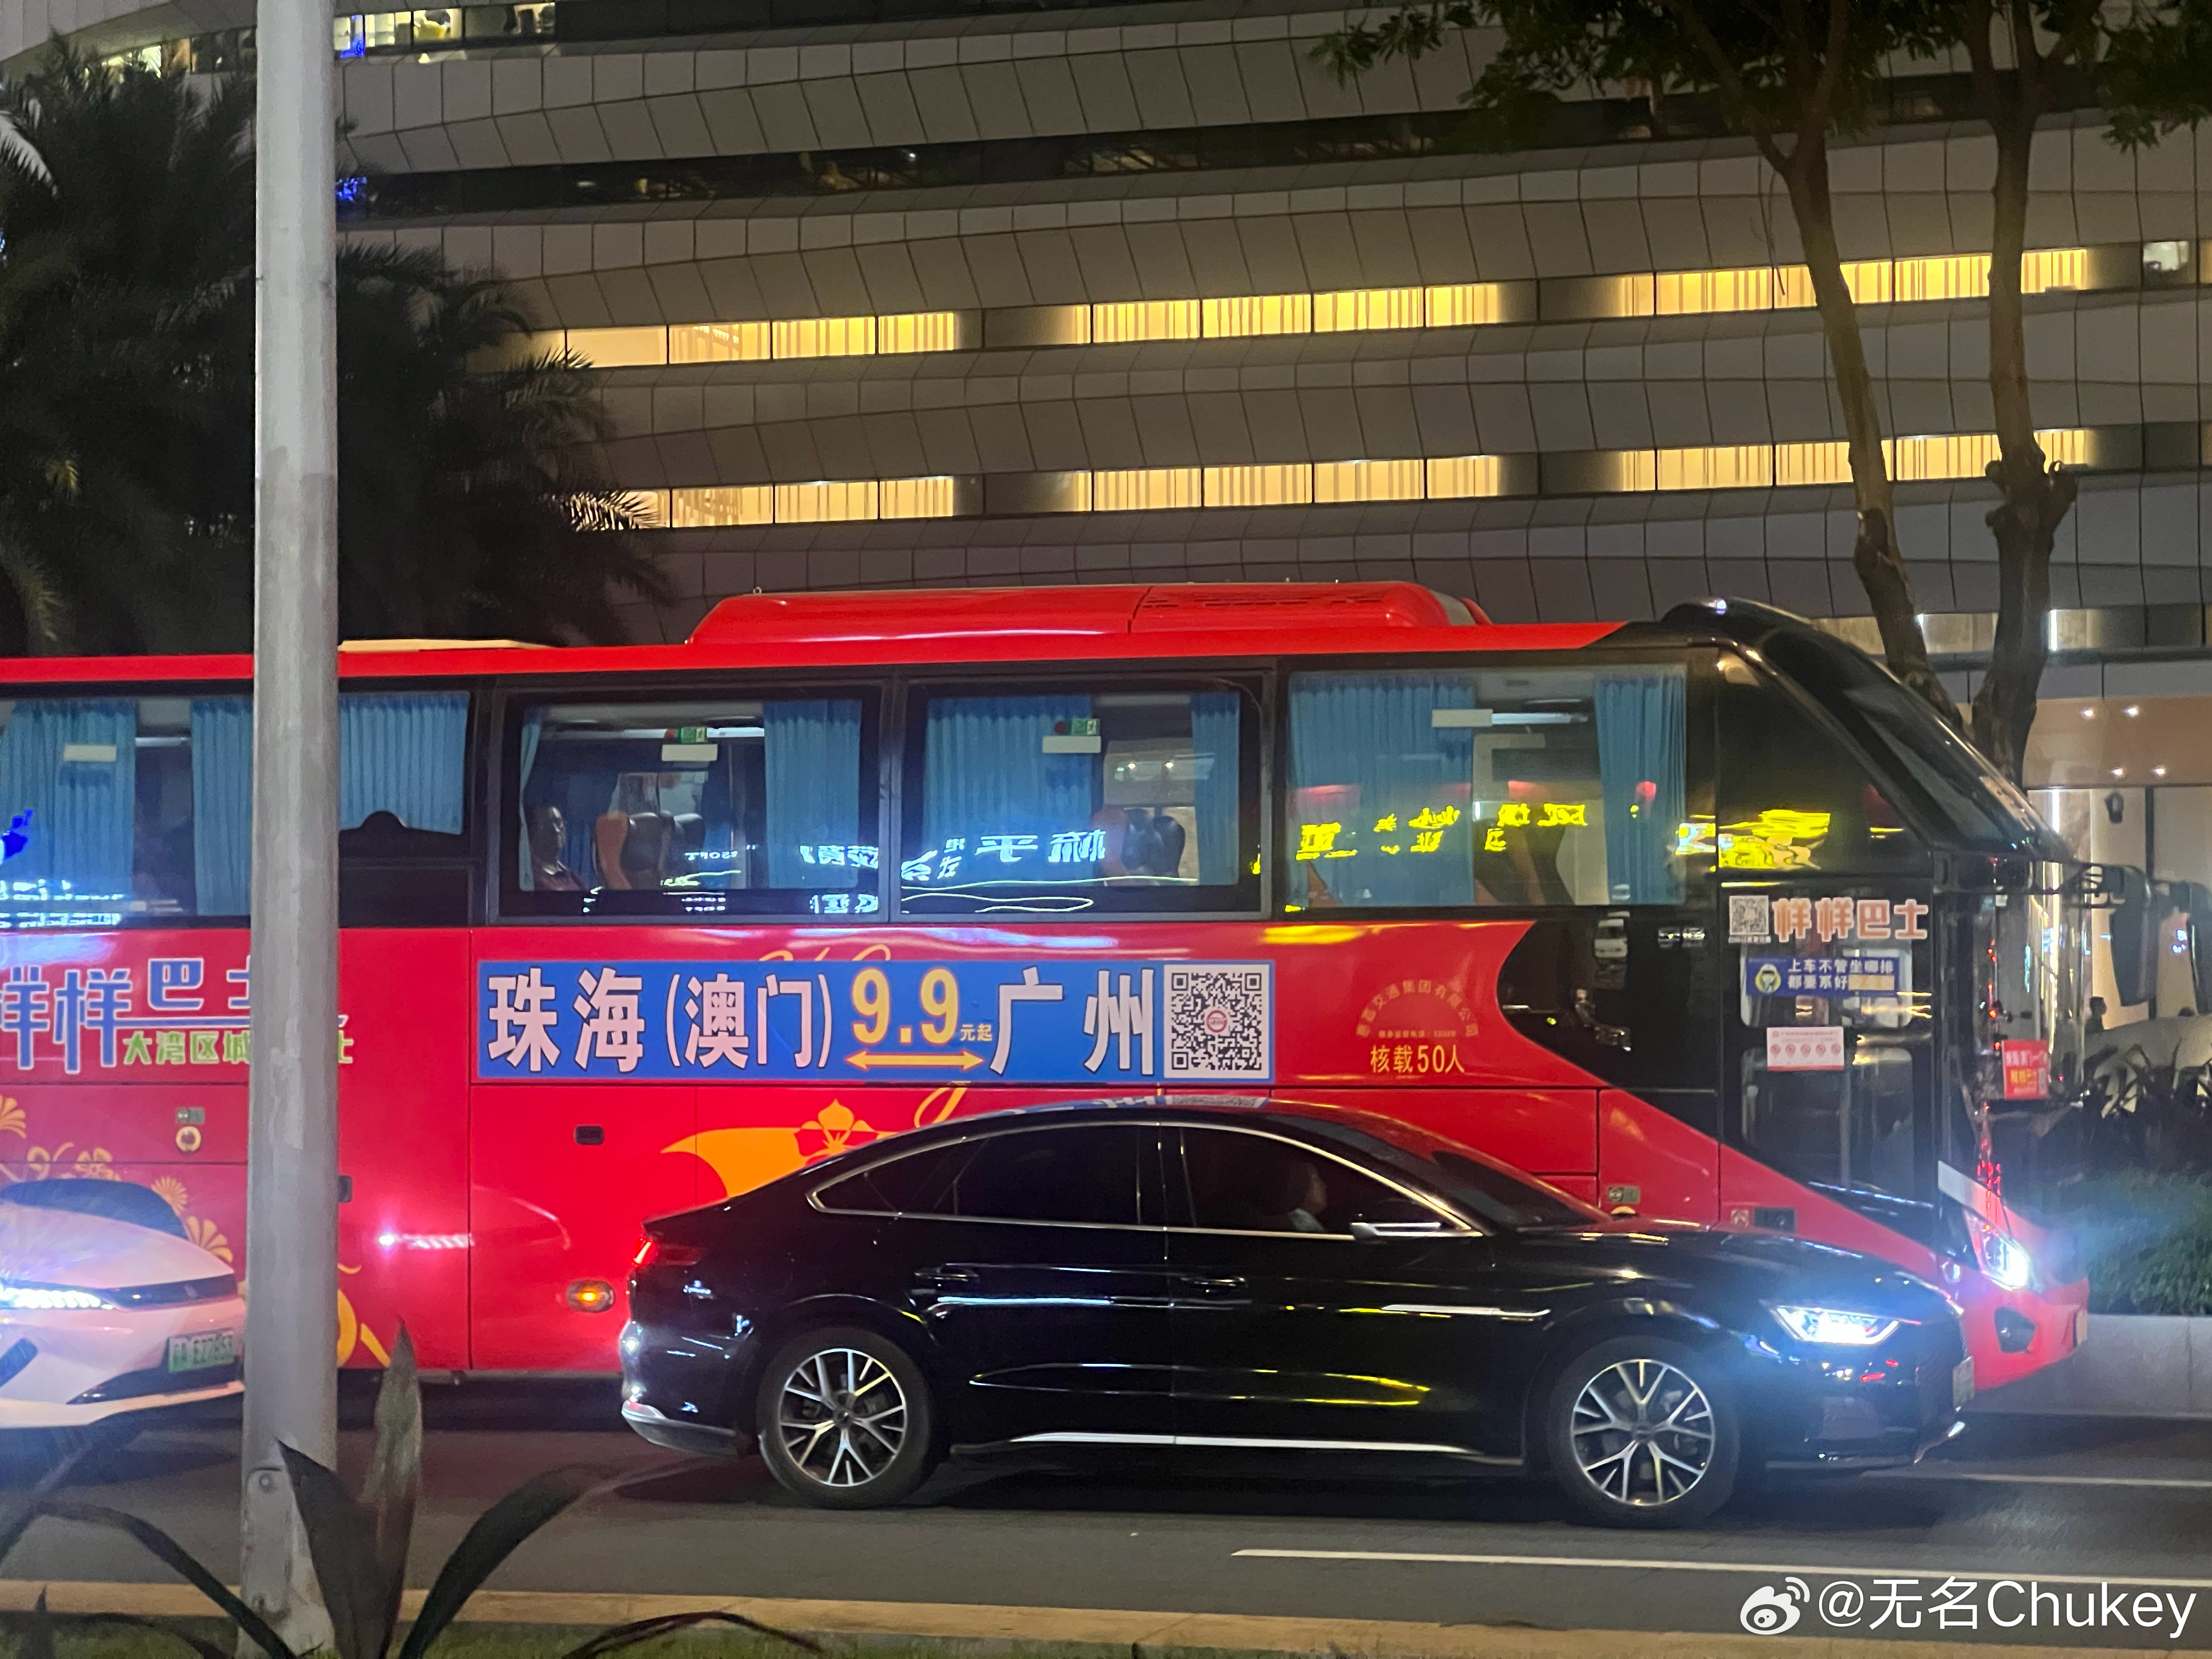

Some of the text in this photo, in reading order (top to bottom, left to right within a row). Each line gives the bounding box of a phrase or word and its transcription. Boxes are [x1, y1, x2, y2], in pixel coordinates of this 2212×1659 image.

[851, 967, 959, 1045] 9.9
[961, 1024, 992, 1041] 元起
[990, 966, 1154, 1075] 广州
[1370, 1045, 1465, 1074] 核载50人
